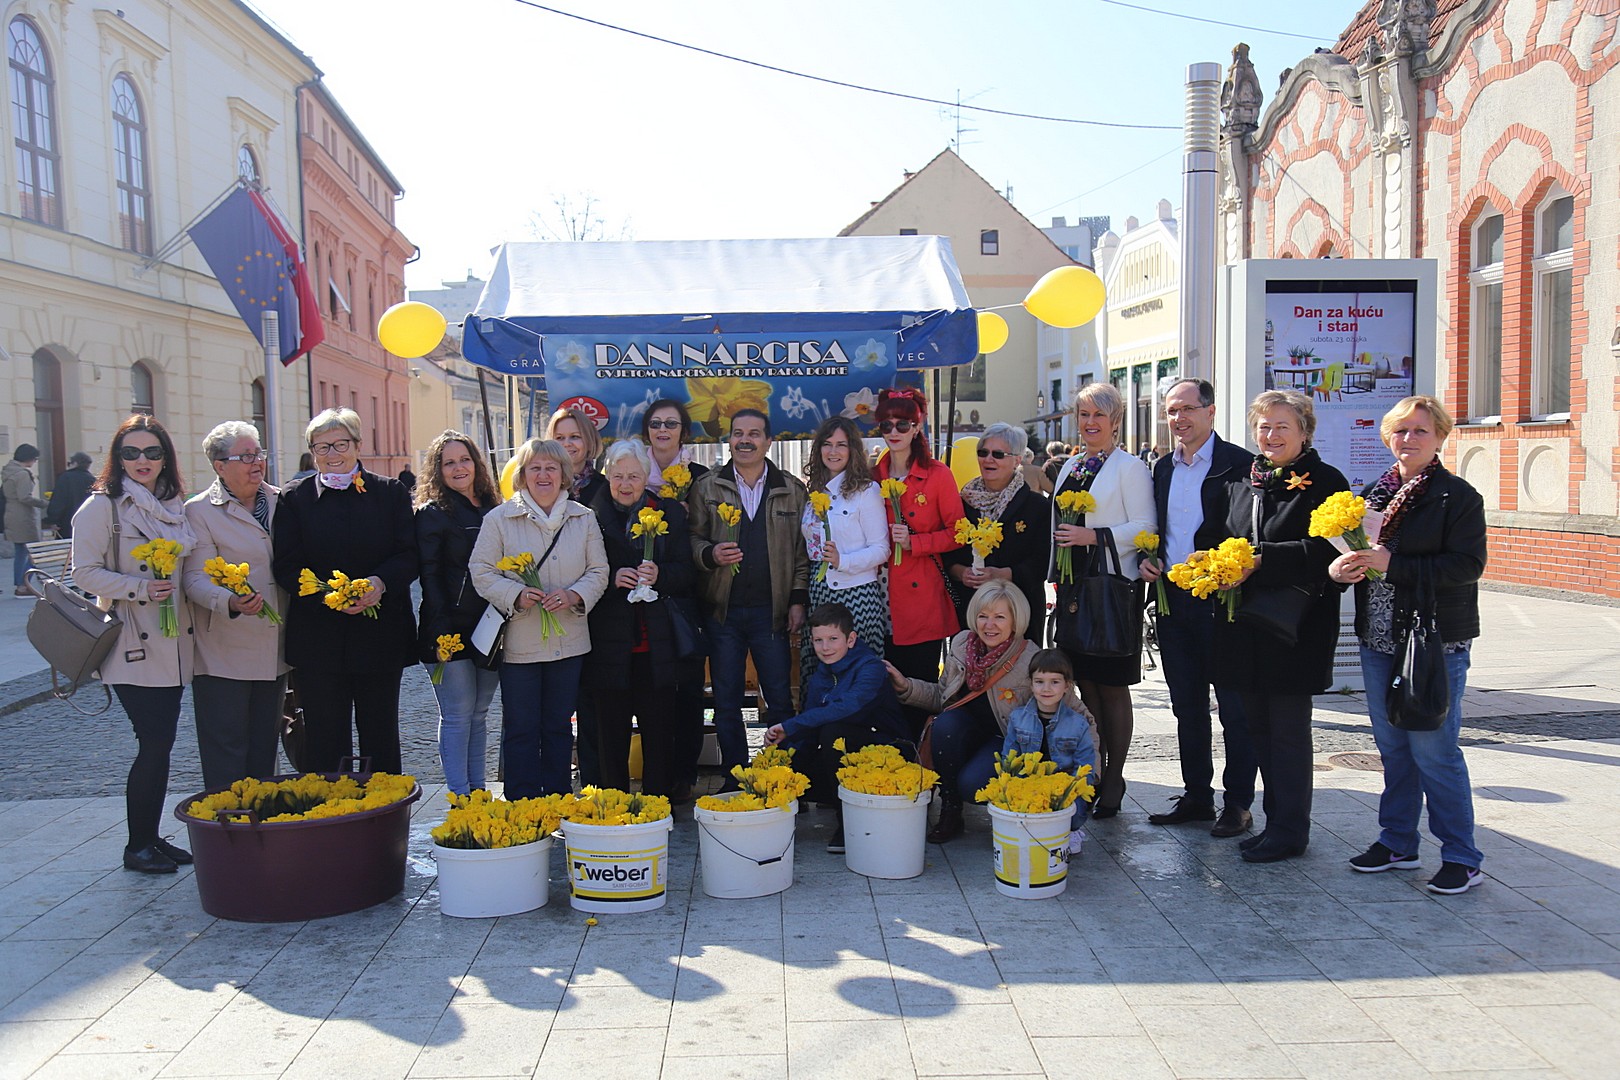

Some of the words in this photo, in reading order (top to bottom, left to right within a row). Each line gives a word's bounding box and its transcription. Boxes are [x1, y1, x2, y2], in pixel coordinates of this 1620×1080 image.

[1294, 305, 1322, 318] Dan
[1327, 308, 1343, 318] za
[1348, 305, 1384, 318] kuću
[1318, 320, 1322, 332] i
[1327, 320, 1358, 332] stan
[595, 342, 673, 367] DAN
[681, 340, 850, 367] NARCISA
[897, 352, 926, 362] VEC
[509, 358, 540, 368] GRA
[596, 368, 657, 378] CVJETOM
[659, 368, 715, 378] NARCISA
[717, 367, 766, 377] PROTIV
[768, 367, 804, 376] RAKA
[806, 366, 849, 376] DOJKE
[585, 864, 650, 882] weber
